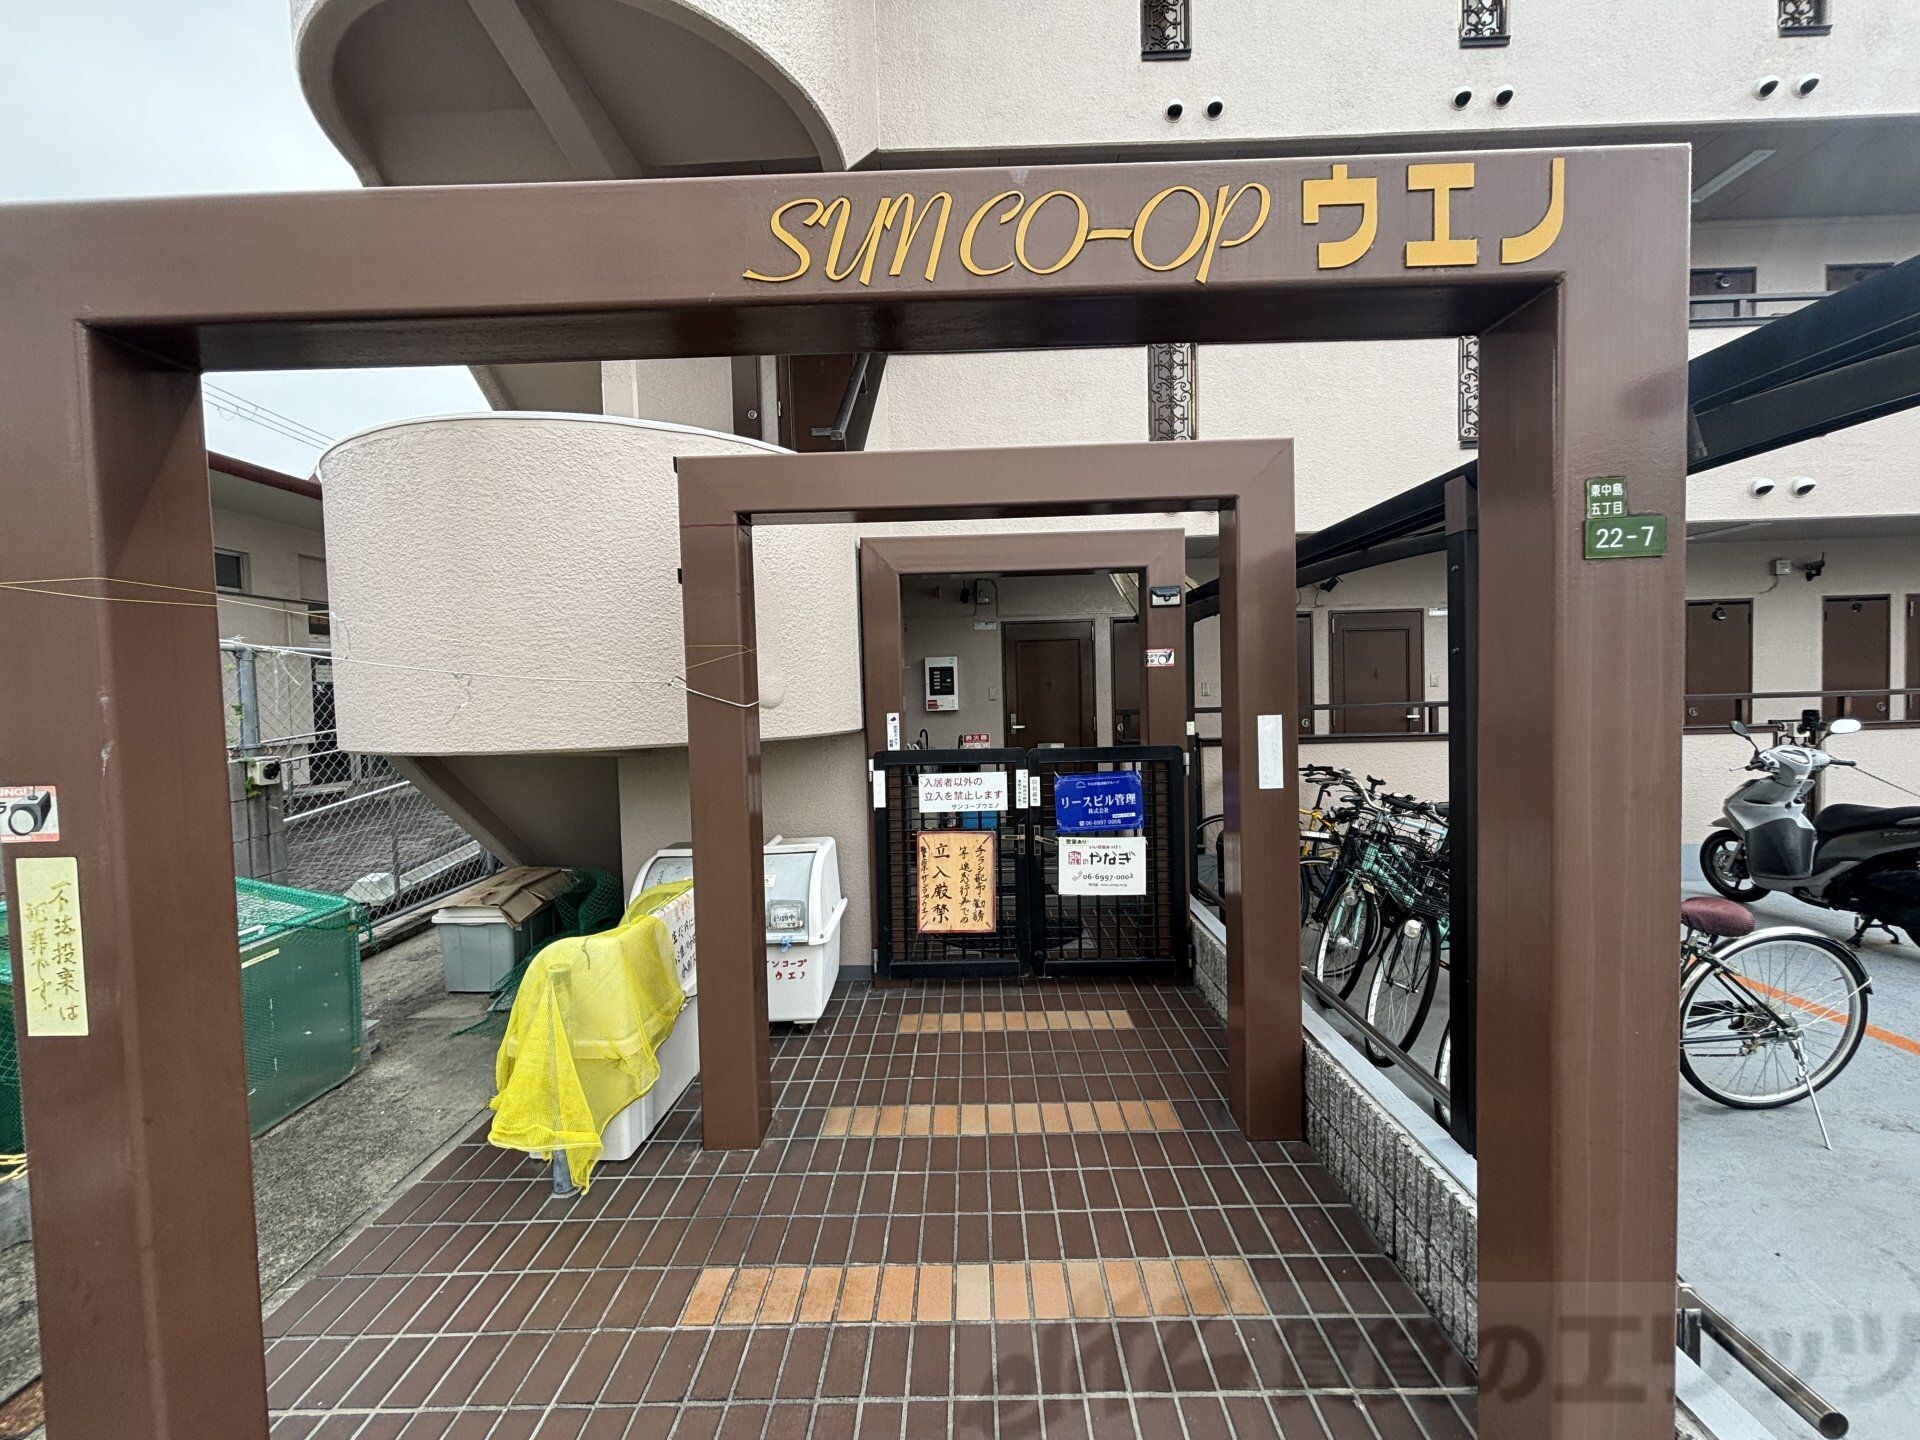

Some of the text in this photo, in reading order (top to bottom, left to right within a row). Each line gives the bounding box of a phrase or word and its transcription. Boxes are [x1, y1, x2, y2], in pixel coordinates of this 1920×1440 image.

[1302, 157, 1566, 269] ウエノ
[1590, 483, 1624, 497] 東中島
[1590, 501, 1623, 516] 五丁目
[1595, 525, 1655, 549] 22-7
[923, 777, 983, 788] 入居者以外の
[924, 790, 1004, 801] 立入を禁止します
[1061, 792, 1137, 809] リースビル管理
[931, 843, 952, 924] 立入厳禁
[48, 880, 81, 1022] 不法投棄は
[775, 970, 806, 980] ウエノ
